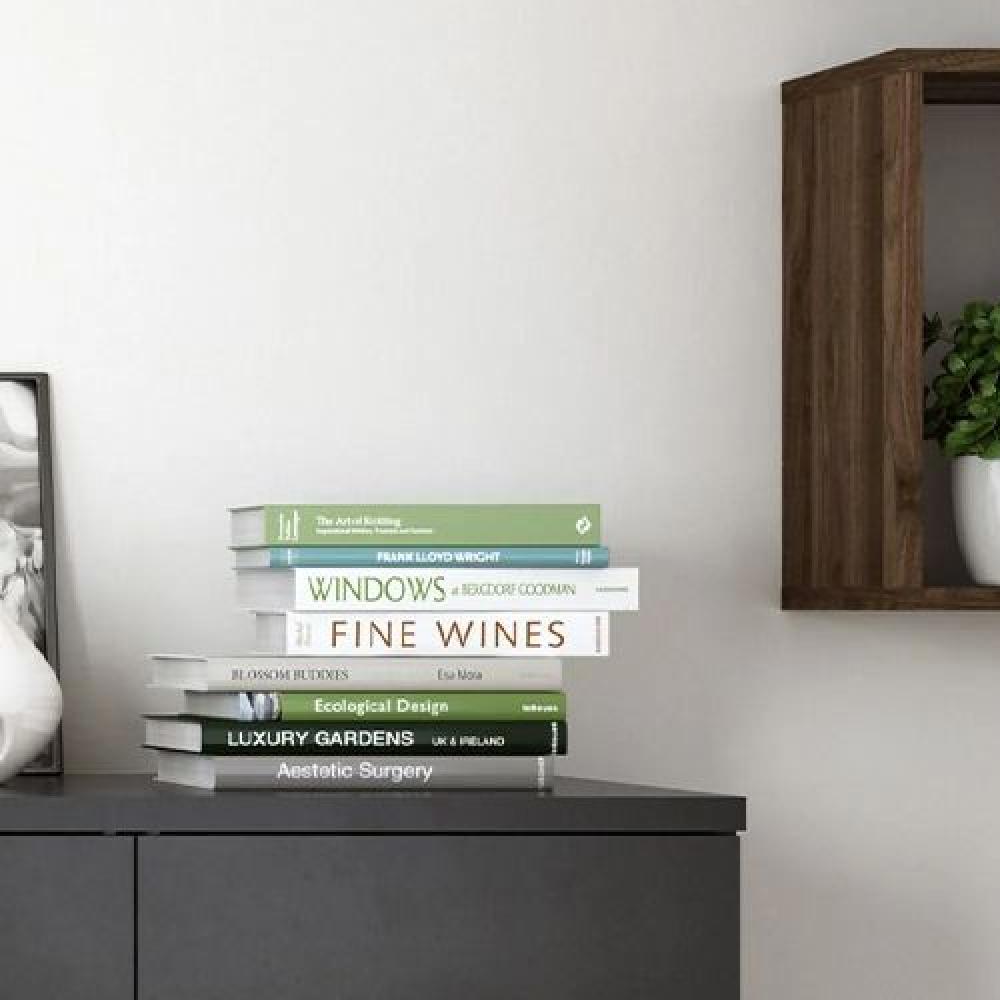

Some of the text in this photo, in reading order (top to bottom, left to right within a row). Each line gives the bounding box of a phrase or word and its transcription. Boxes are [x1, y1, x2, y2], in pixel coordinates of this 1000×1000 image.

[377, 551, 501, 563] FRANK LLOYD WRIGHT
[308, 576, 446, 602] WINDOWS
[331, 620, 417, 648] FINE
[435, 620, 566, 649] WINES
[314, 698, 449, 717] Ecological Design
[226, 729, 309, 747] LUXURY
[314, 729, 415, 747] GARDENS
[358, 760, 433, 783] Surgery
